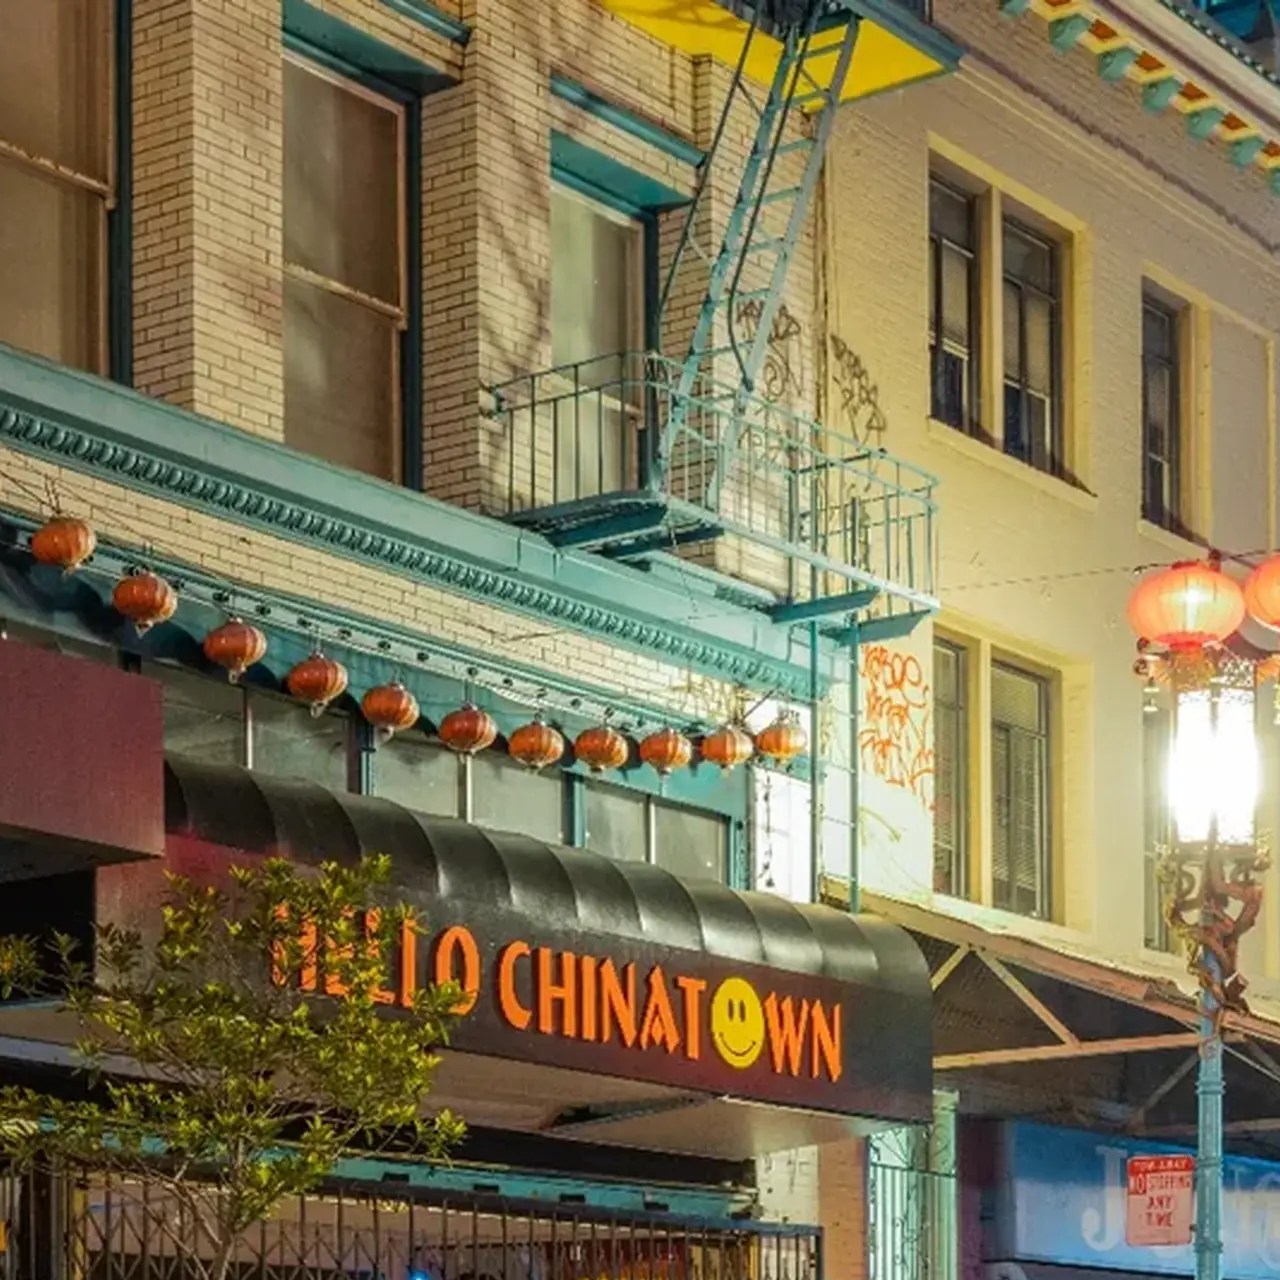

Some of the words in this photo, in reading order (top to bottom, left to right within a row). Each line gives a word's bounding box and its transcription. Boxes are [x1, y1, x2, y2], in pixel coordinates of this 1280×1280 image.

[1130, 1174, 1146, 1194] NO
[1148, 1174, 1191, 1190] STOPPING
[1147, 1195, 1172, 1208] ANY
[1146, 1212, 1173, 1227] TIME
